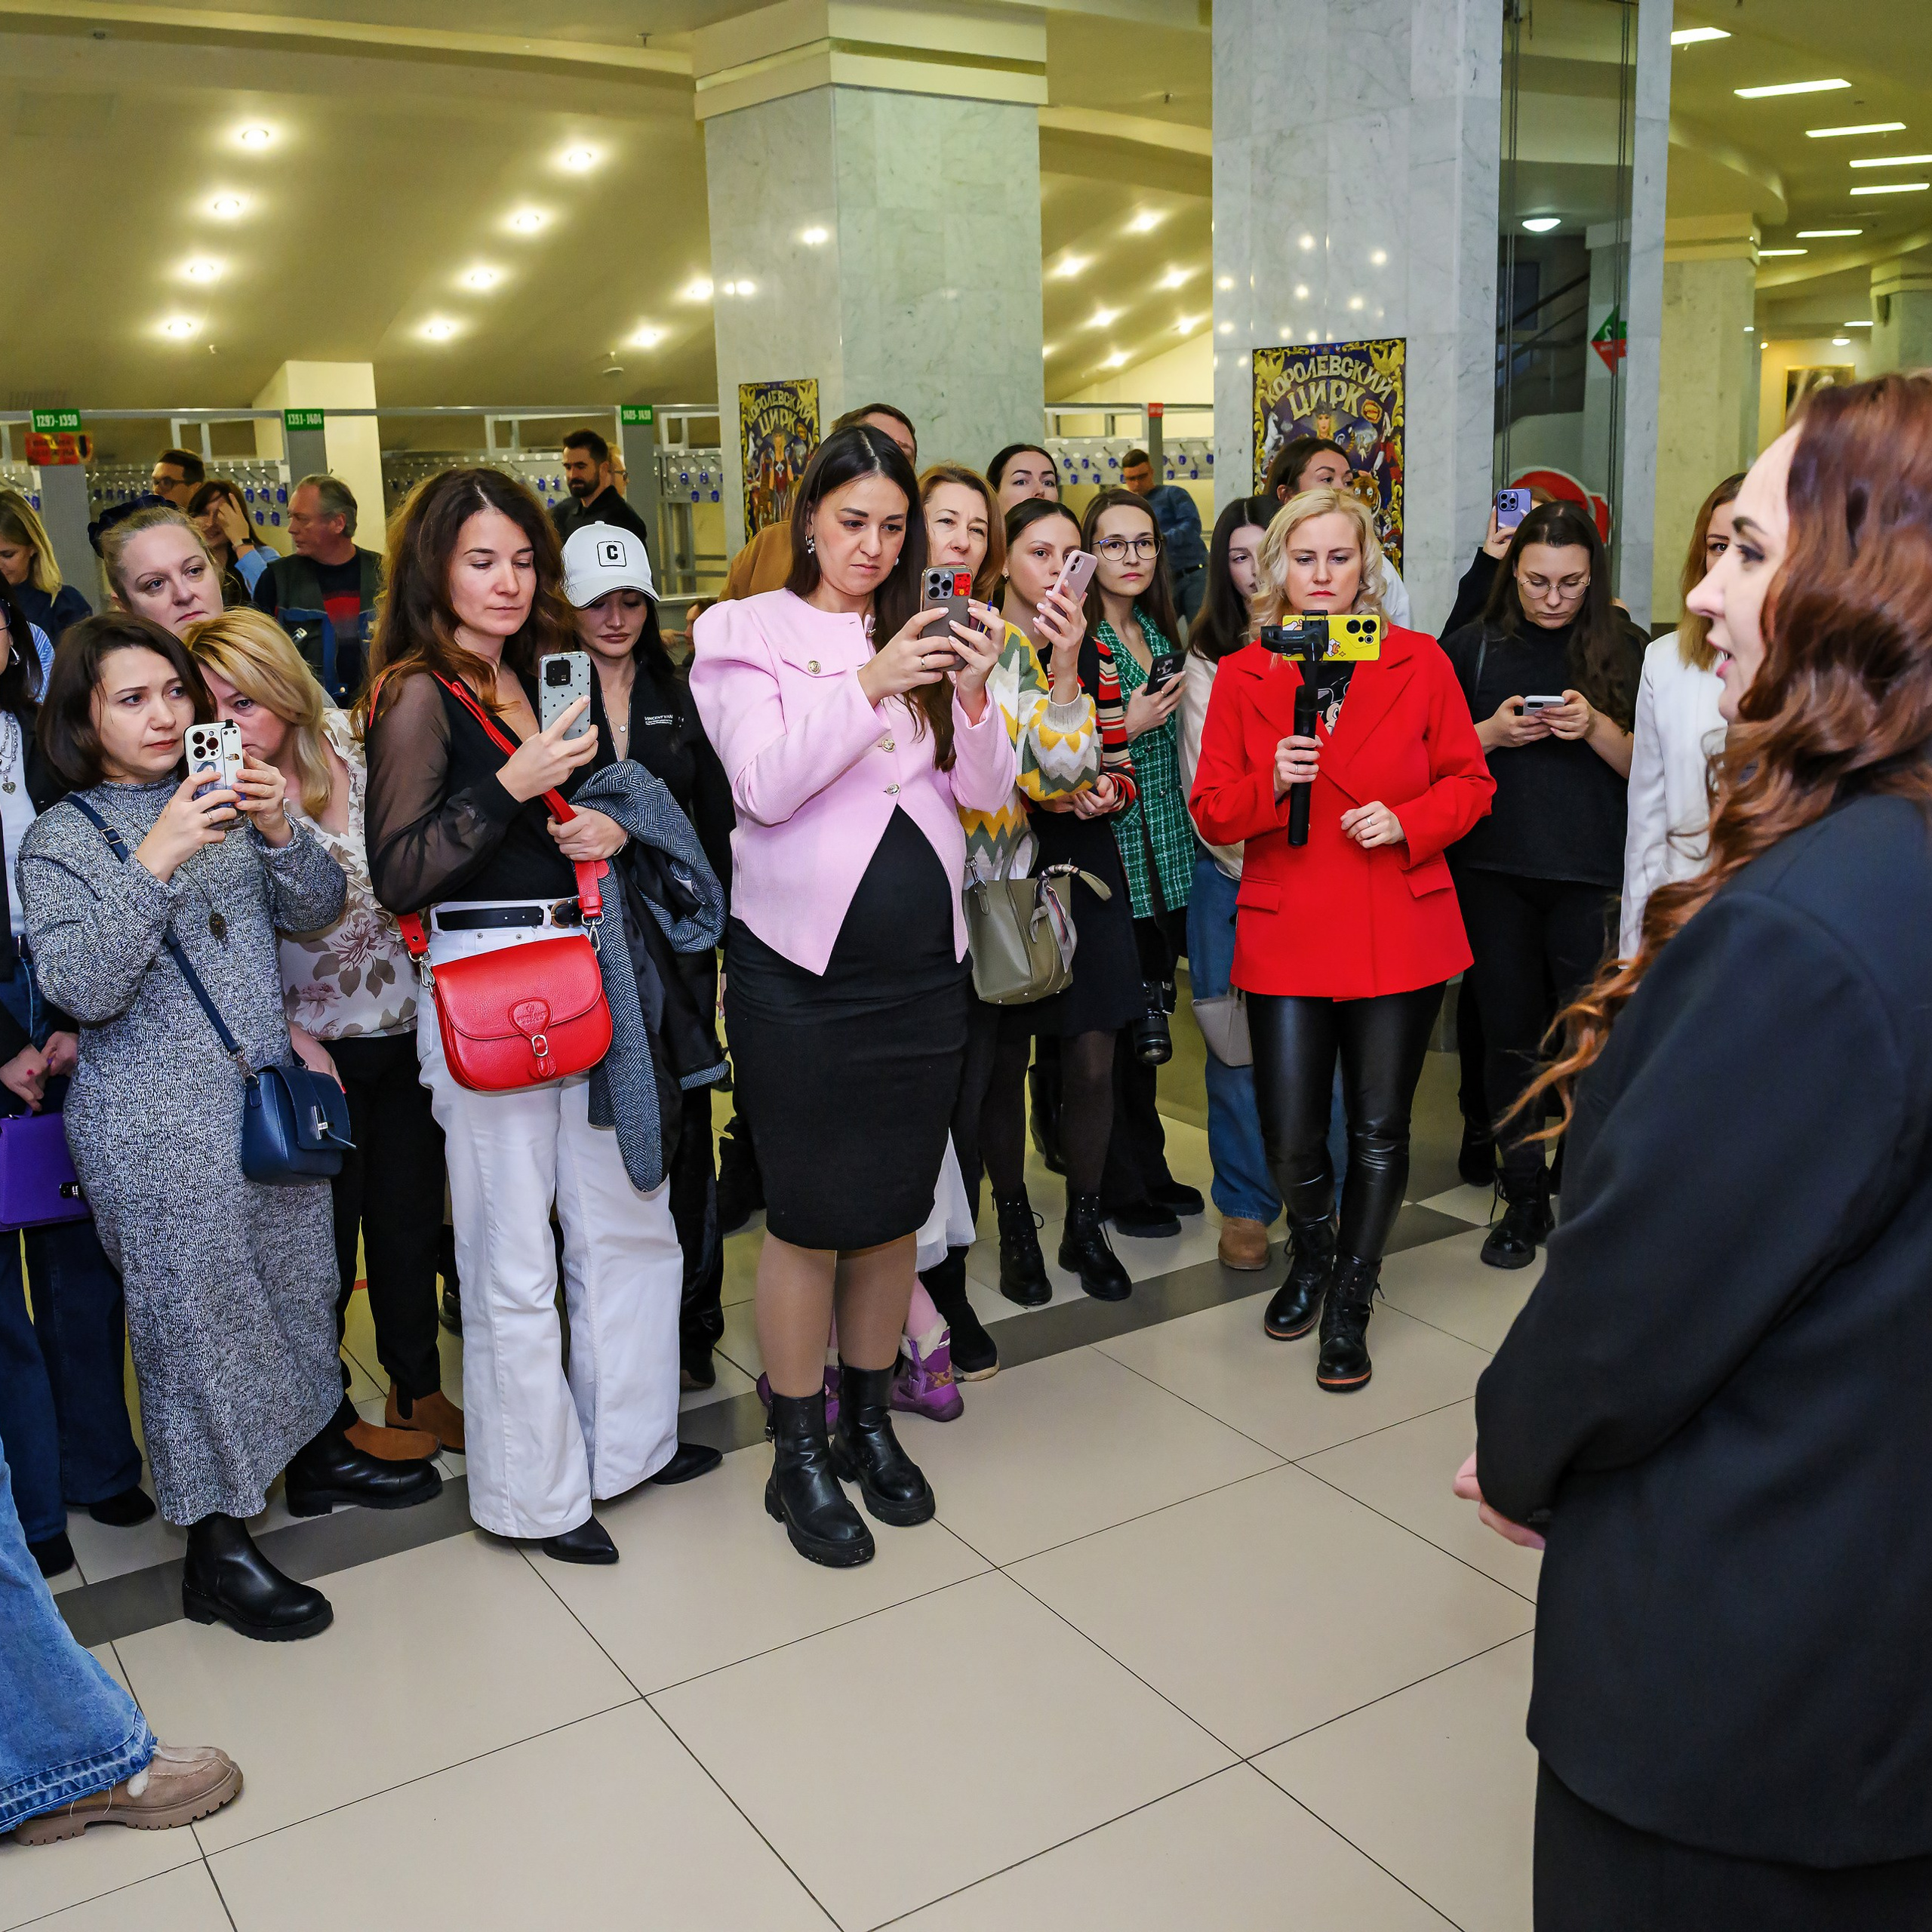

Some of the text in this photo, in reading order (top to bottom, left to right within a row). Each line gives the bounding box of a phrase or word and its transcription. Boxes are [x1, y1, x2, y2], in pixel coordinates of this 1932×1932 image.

[1263, 354, 1394, 408] КОРОЛЕВСКИЙ
[1286, 379, 1367, 421] ЦИРК
[746, 389, 813, 428] КОРОЛЕВСКИЙ
[758, 408, 798, 438] ЦИРК
[606, 544, 618, 559] C
